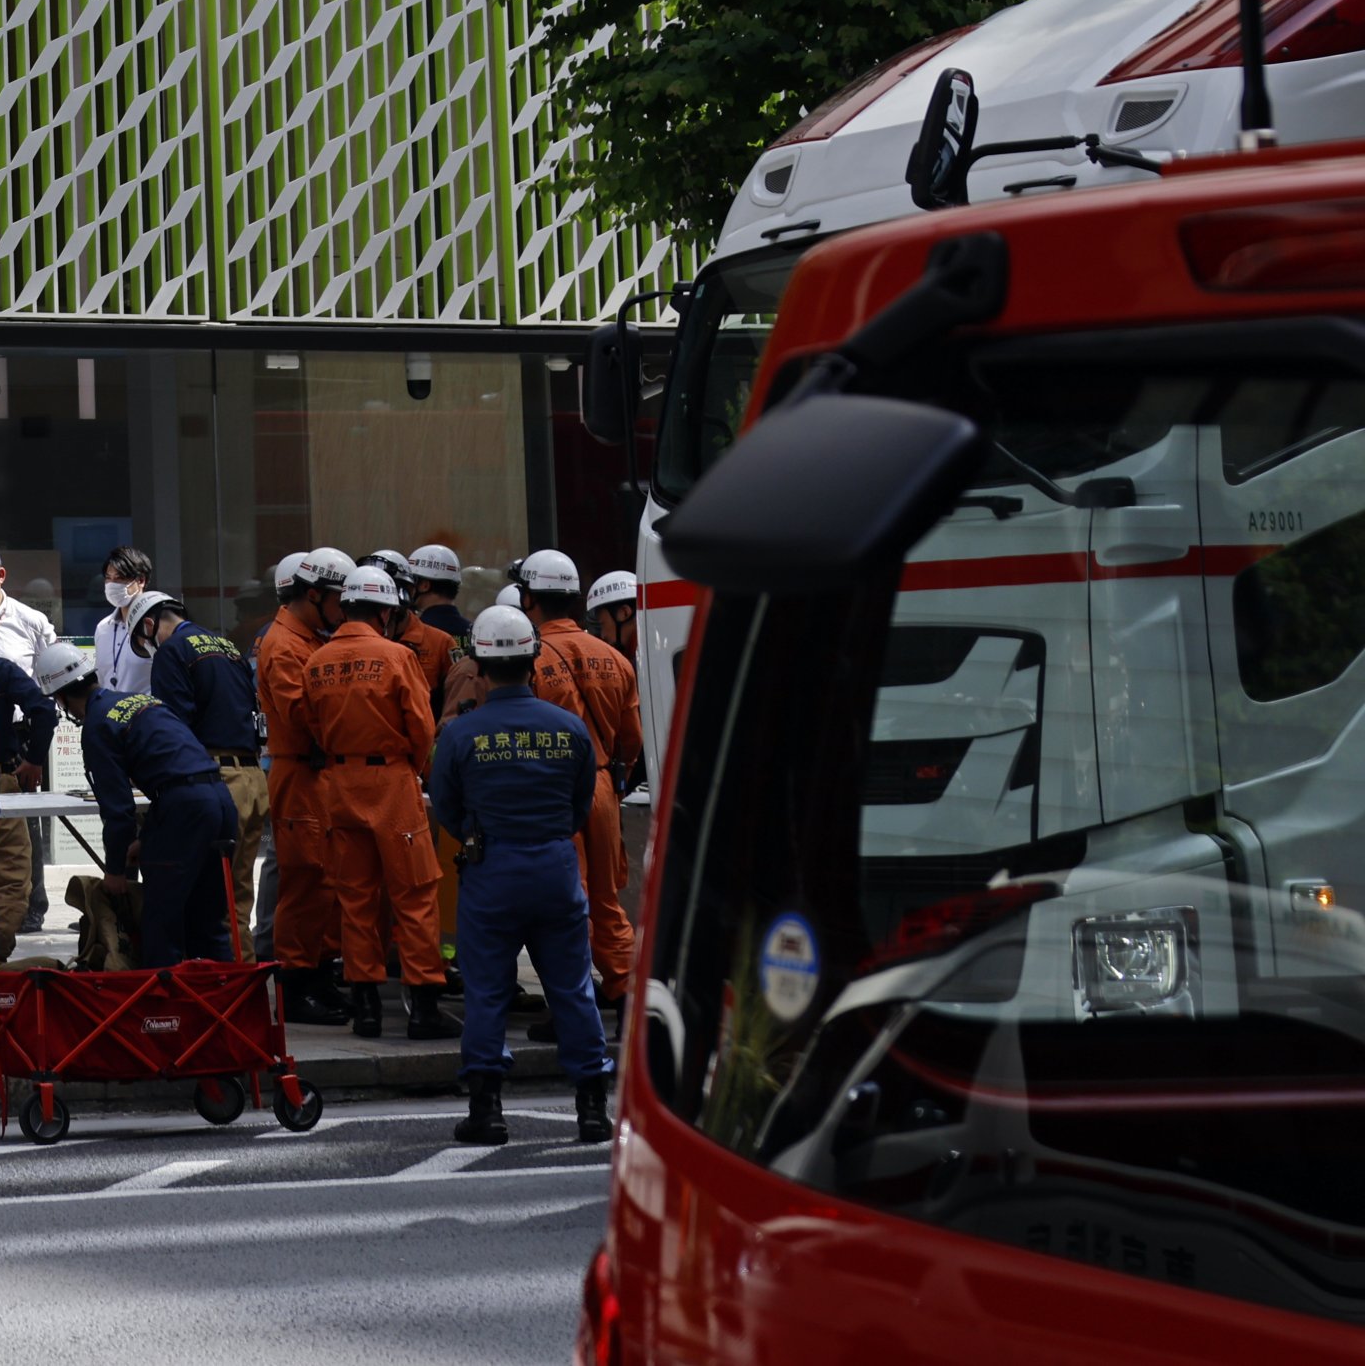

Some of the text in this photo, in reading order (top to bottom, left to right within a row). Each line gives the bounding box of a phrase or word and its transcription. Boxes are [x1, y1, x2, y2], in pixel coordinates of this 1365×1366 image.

[1248, 512, 1304, 532] A29001
[594, 582, 628, 597] 東京消防庁
[309, 659, 384, 678] 東京消防庁
[474, 731, 571, 751] 東京消防庁
[475, 750, 512, 762] TOKYO
[517, 749, 540, 759] FIRE
